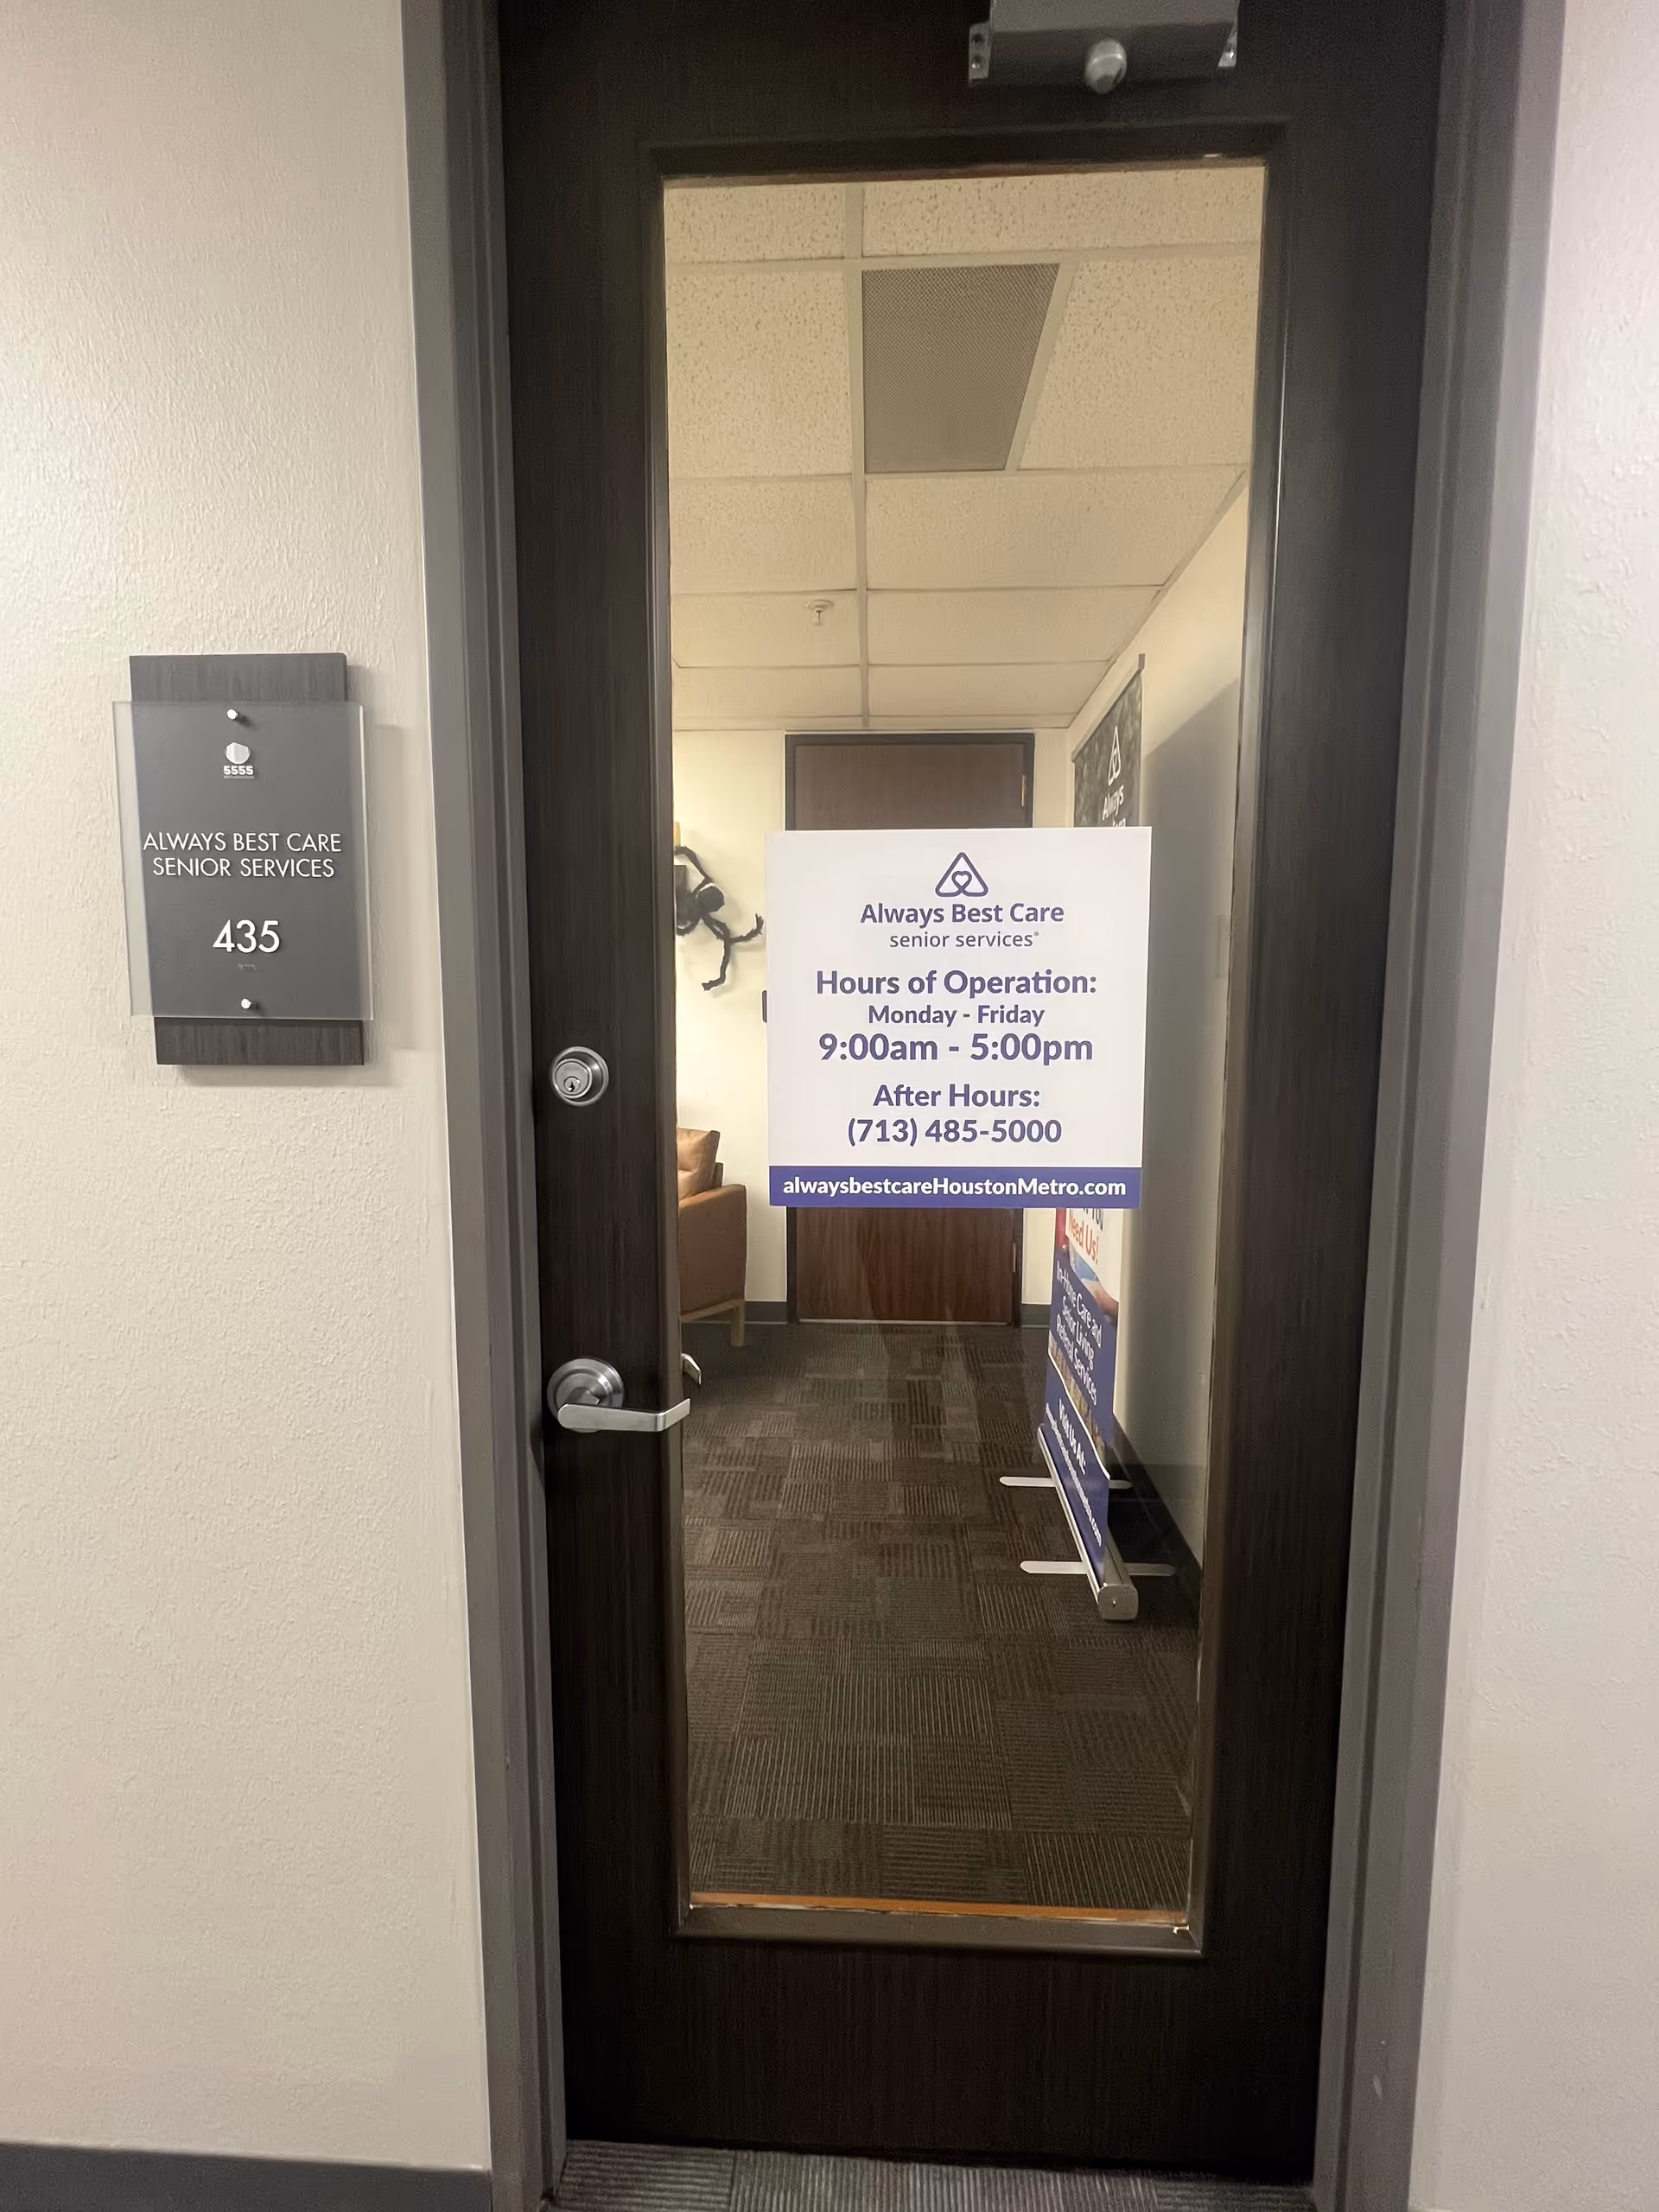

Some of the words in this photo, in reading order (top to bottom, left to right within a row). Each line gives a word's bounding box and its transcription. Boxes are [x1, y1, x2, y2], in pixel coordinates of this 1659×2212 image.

[223, 765, 254, 776] 5555
[143, 832, 226, 852] ALWAYS
[232, 832, 280, 852] BEST
[286, 832, 342, 852] CARE
[152, 857, 232, 877] SENIOR
[239, 857, 334, 878] SERVICES
[860, 903, 945, 929] Always
[951, 903, 1003, 923] Best
[1009, 902, 1065, 923] Care
[212, 919, 281, 953] 435
[889, 931, 950, 948] senior
[817, 970, 900, 995] Hours
[907, 969, 938, 995] of
[944, 969, 1096, 1000] Operation:
[868, 1005, 957, 1027] Monday
[976, 1004, 1046, 1027] Friday
[818, 1033, 938, 1061] 9:00am
[969, 1033, 1093, 1066] 5:00pm
[872, 1084, 942, 1107] After
[949, 1084, 1040, 1108] Hours:
[848, 1117, 918, 1147] (713)
[925, 1119, 1062, 1143] 485-5000
[783, 1176, 1127, 1198] alwaysbestcareHoustonMetro.com
[1086, 1225, 1098, 1264] Us!
[1077, 1293, 1091, 1329] Care
[1077, 1320, 1095, 1370] Living
[1074, 1347, 1097, 1406] Services
